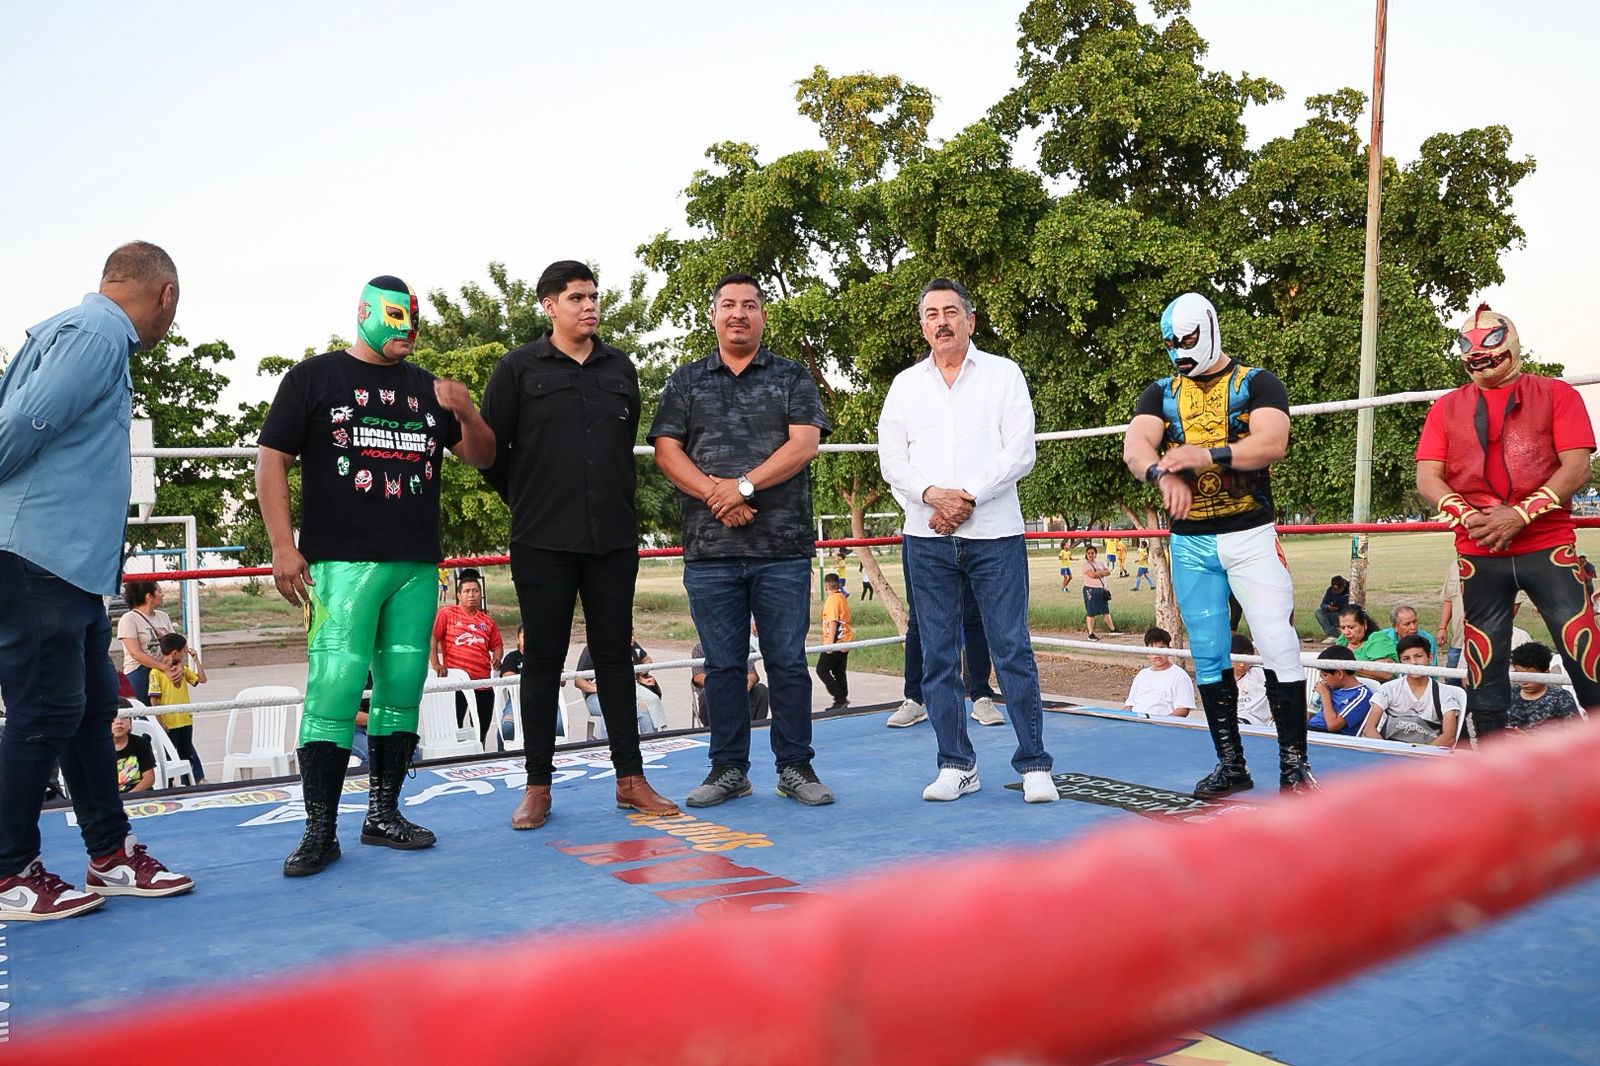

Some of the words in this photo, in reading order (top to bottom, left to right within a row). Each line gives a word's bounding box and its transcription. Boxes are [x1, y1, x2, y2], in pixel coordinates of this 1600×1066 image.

[361, 416, 399, 429] ESTO
[403, 421, 423, 431] ES
[352, 426, 395, 449] LUCHA
[394, 432, 427, 452] LIBRE
[361, 449, 421, 462] NOGALES
[1053, 773, 1224, 807] Asociados
[1058, 784, 1197, 815] Miranda
